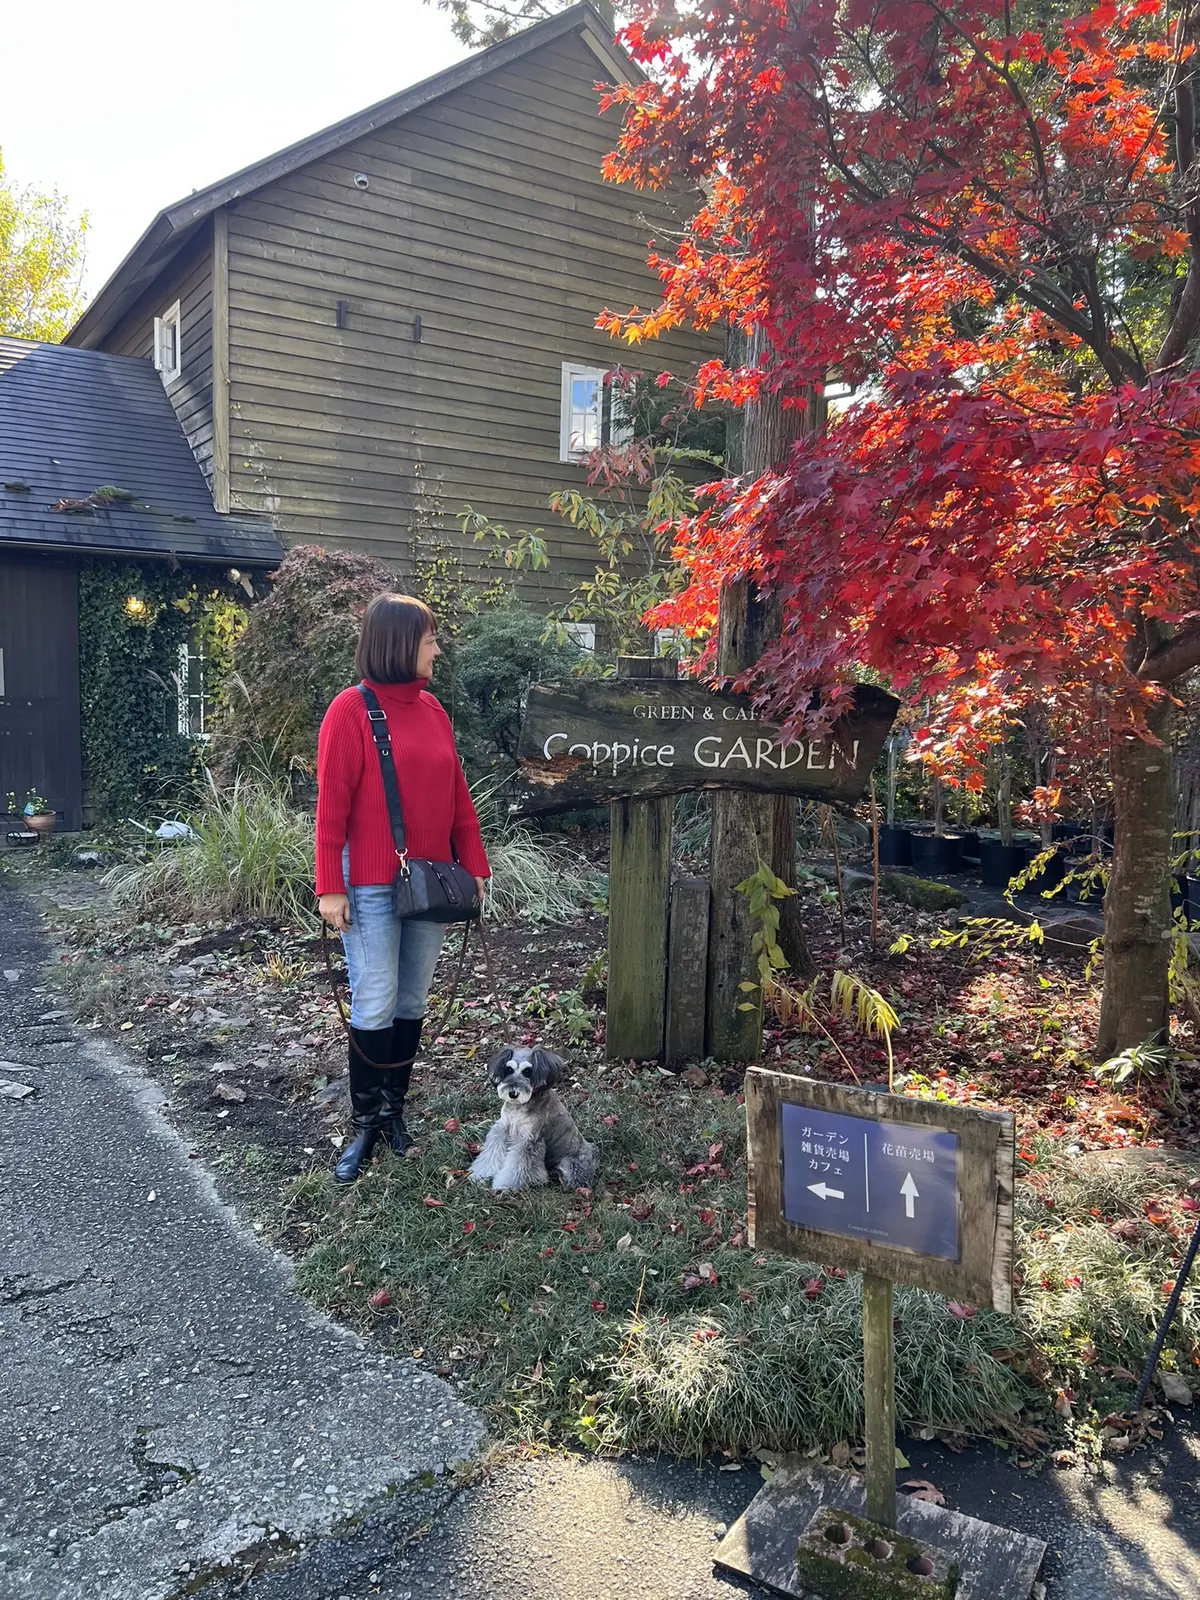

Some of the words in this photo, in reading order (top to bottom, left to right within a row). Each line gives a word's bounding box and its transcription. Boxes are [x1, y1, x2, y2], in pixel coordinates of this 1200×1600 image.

[633, 704, 695, 720] GREEN
[702, 705, 715, 721] &
[694, 736, 859, 770] GARDEN
[801, 1127, 849, 1145] ガーデン
[801, 1141, 850, 1163] 雑貨売場
[881, 1142, 935, 1164] 花苗売場
[808, 1159, 843, 1176] カフェ
